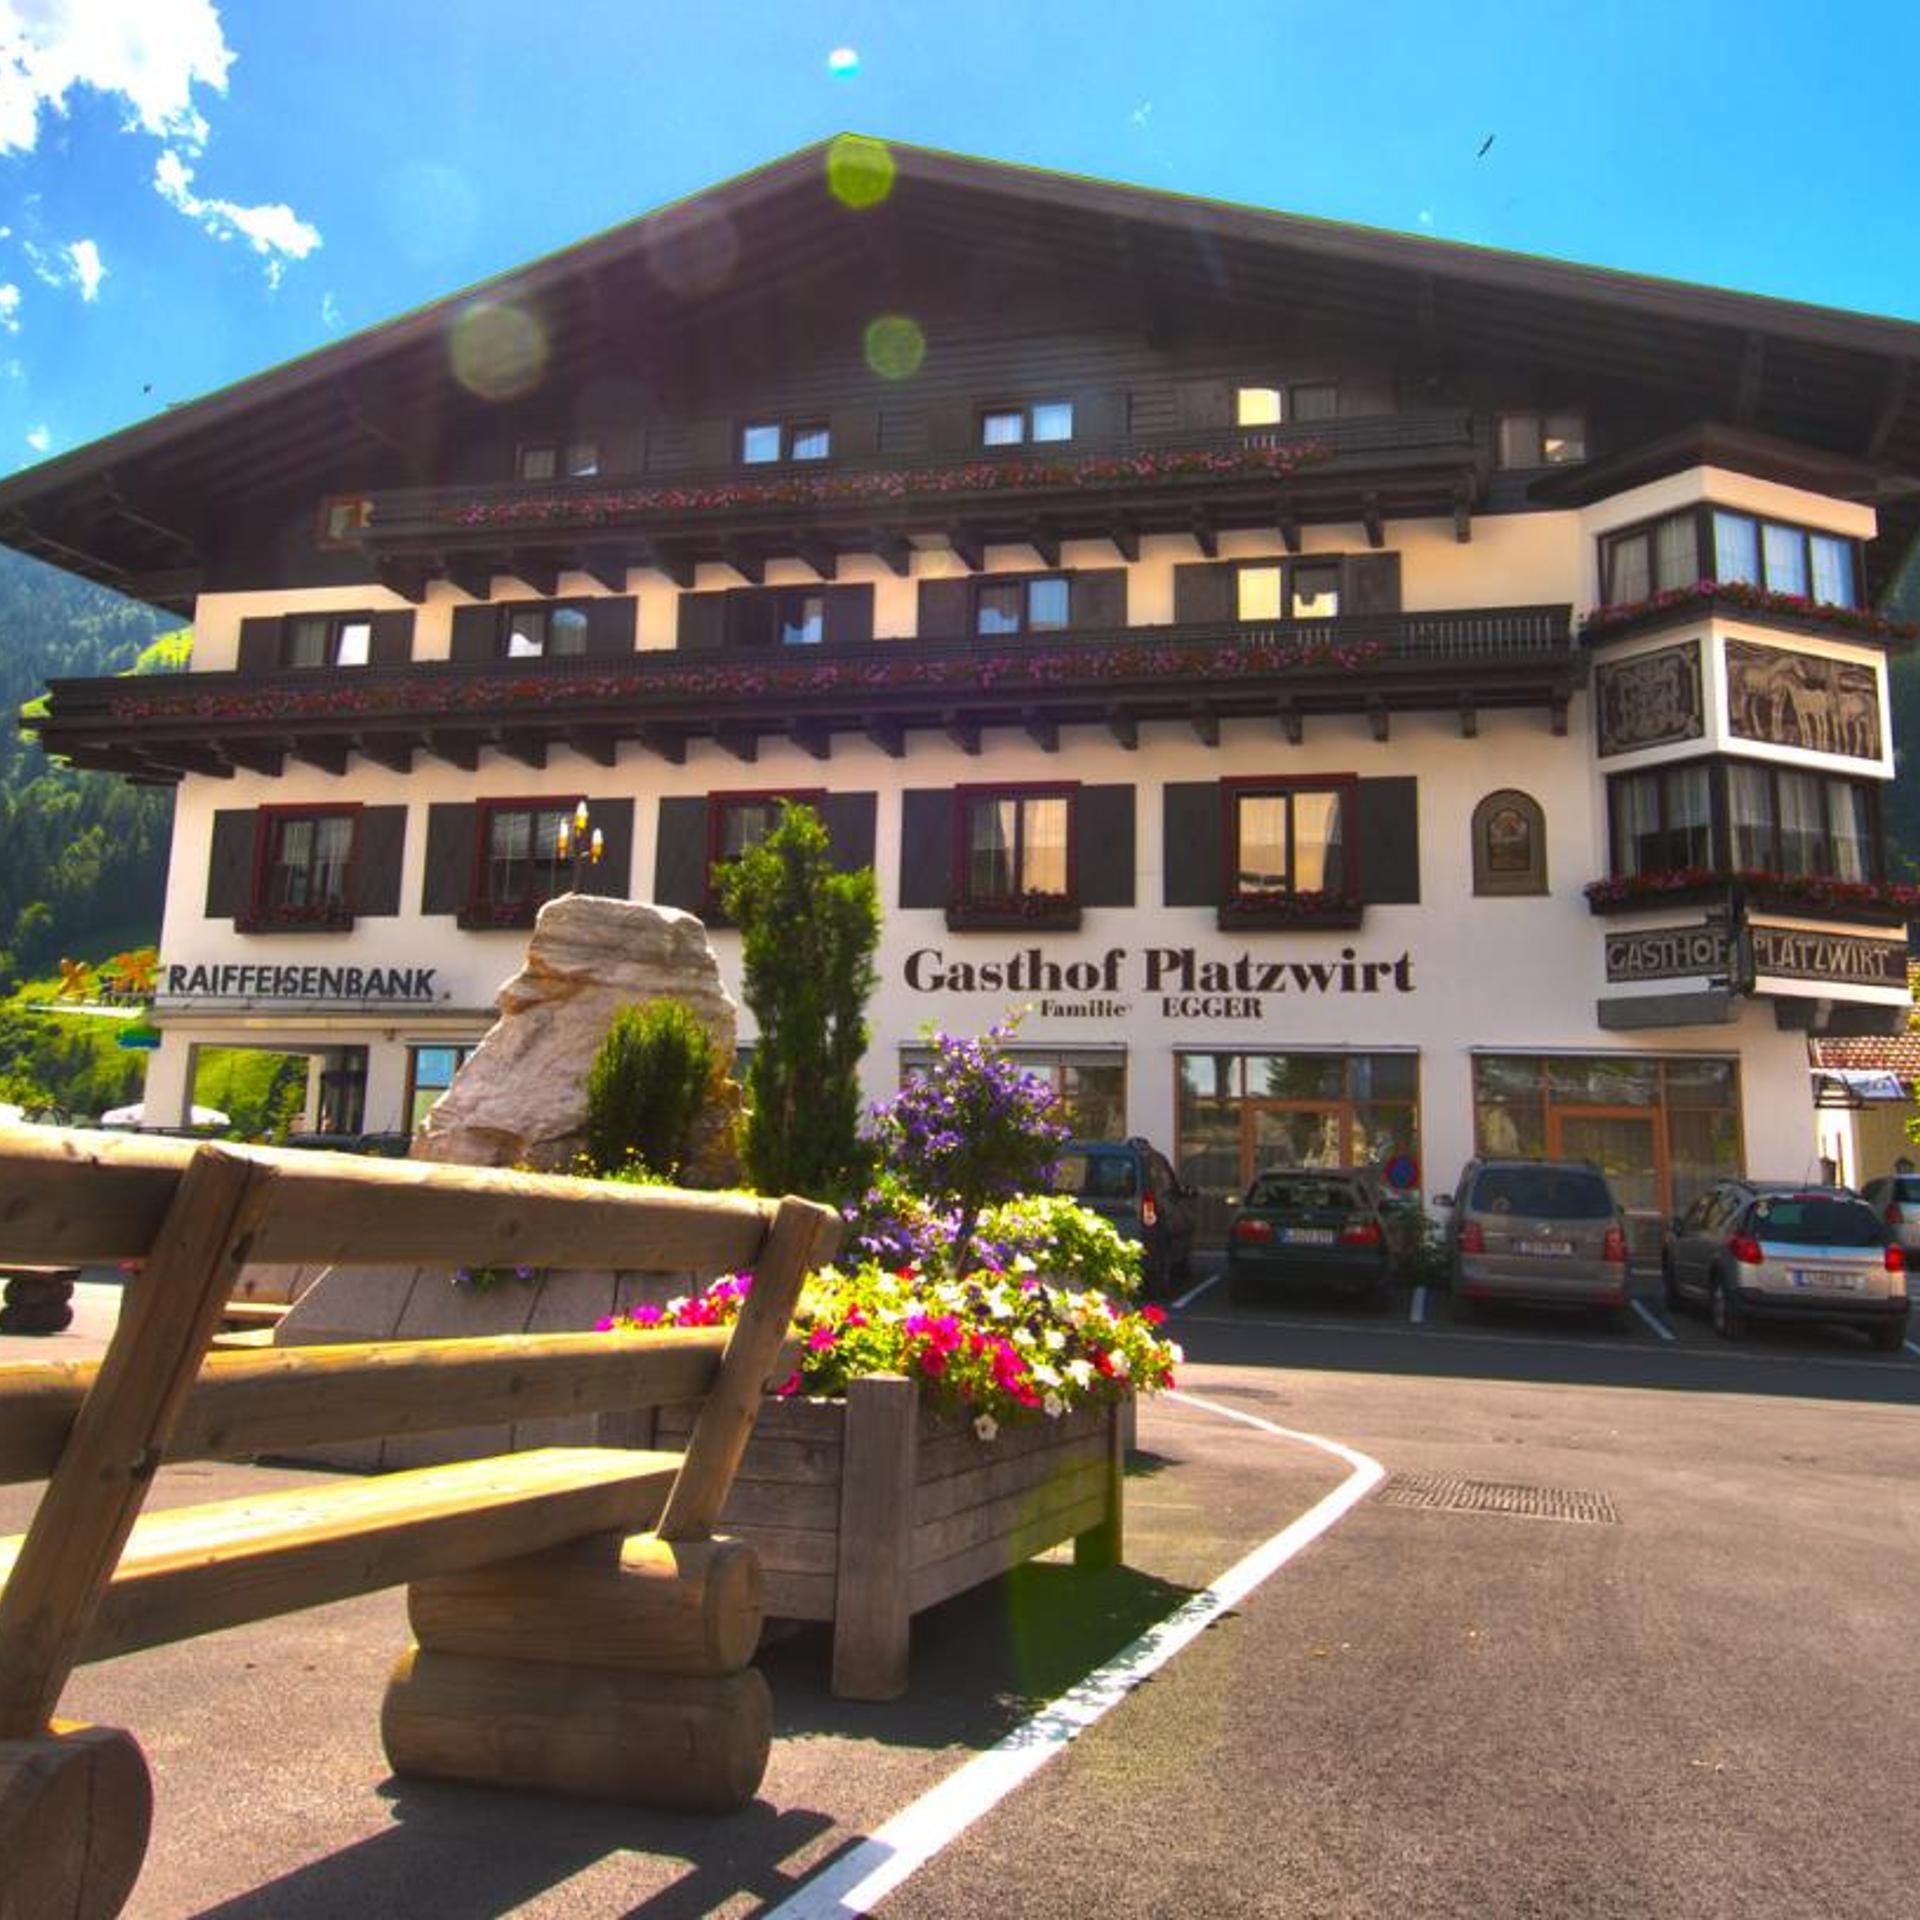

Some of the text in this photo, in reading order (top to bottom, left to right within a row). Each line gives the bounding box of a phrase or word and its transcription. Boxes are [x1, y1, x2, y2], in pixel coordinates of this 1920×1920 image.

[904, 947, 1416, 992] Gasthof Platzwirt
[1608, 933, 1889, 977] GASTHOF PLATZWIRT
[169, 964, 436, 997] RAIFFEISENBANK
[1041, 997, 1262, 1018] Familie EGGER
